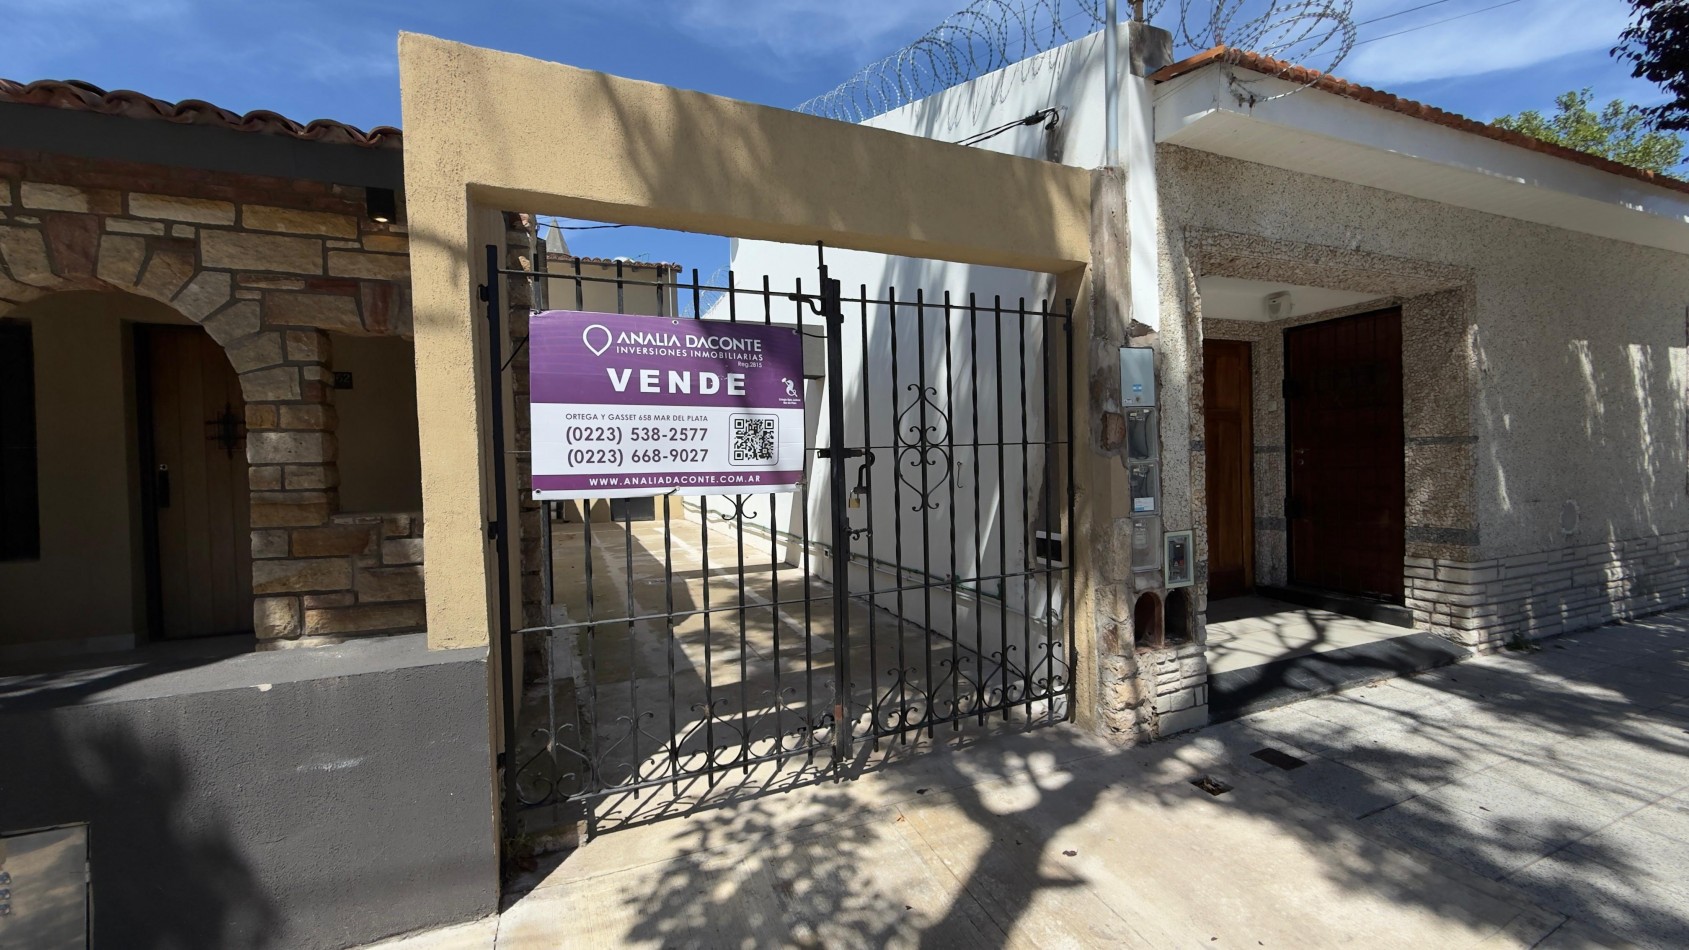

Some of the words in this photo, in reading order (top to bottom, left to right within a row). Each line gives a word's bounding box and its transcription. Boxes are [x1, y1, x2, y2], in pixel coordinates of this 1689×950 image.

[616, 331, 681, 347] ANALIA
[685, 335, 762, 352] DACONTE
[616, 346, 687, 357] INVERSIONES
[690, 350, 763, 361] INMOBILIARIAS
[606, 367, 746, 396] VENDE
[566, 426, 622, 445] (0223)
[630, 427, 708, 441] 538-2577
[567, 449, 623, 467] (0223)
[631, 449, 709, 463] 668-9027
[589, 475, 761, 486] WWW.ANALIADACONTE.COM.AR
